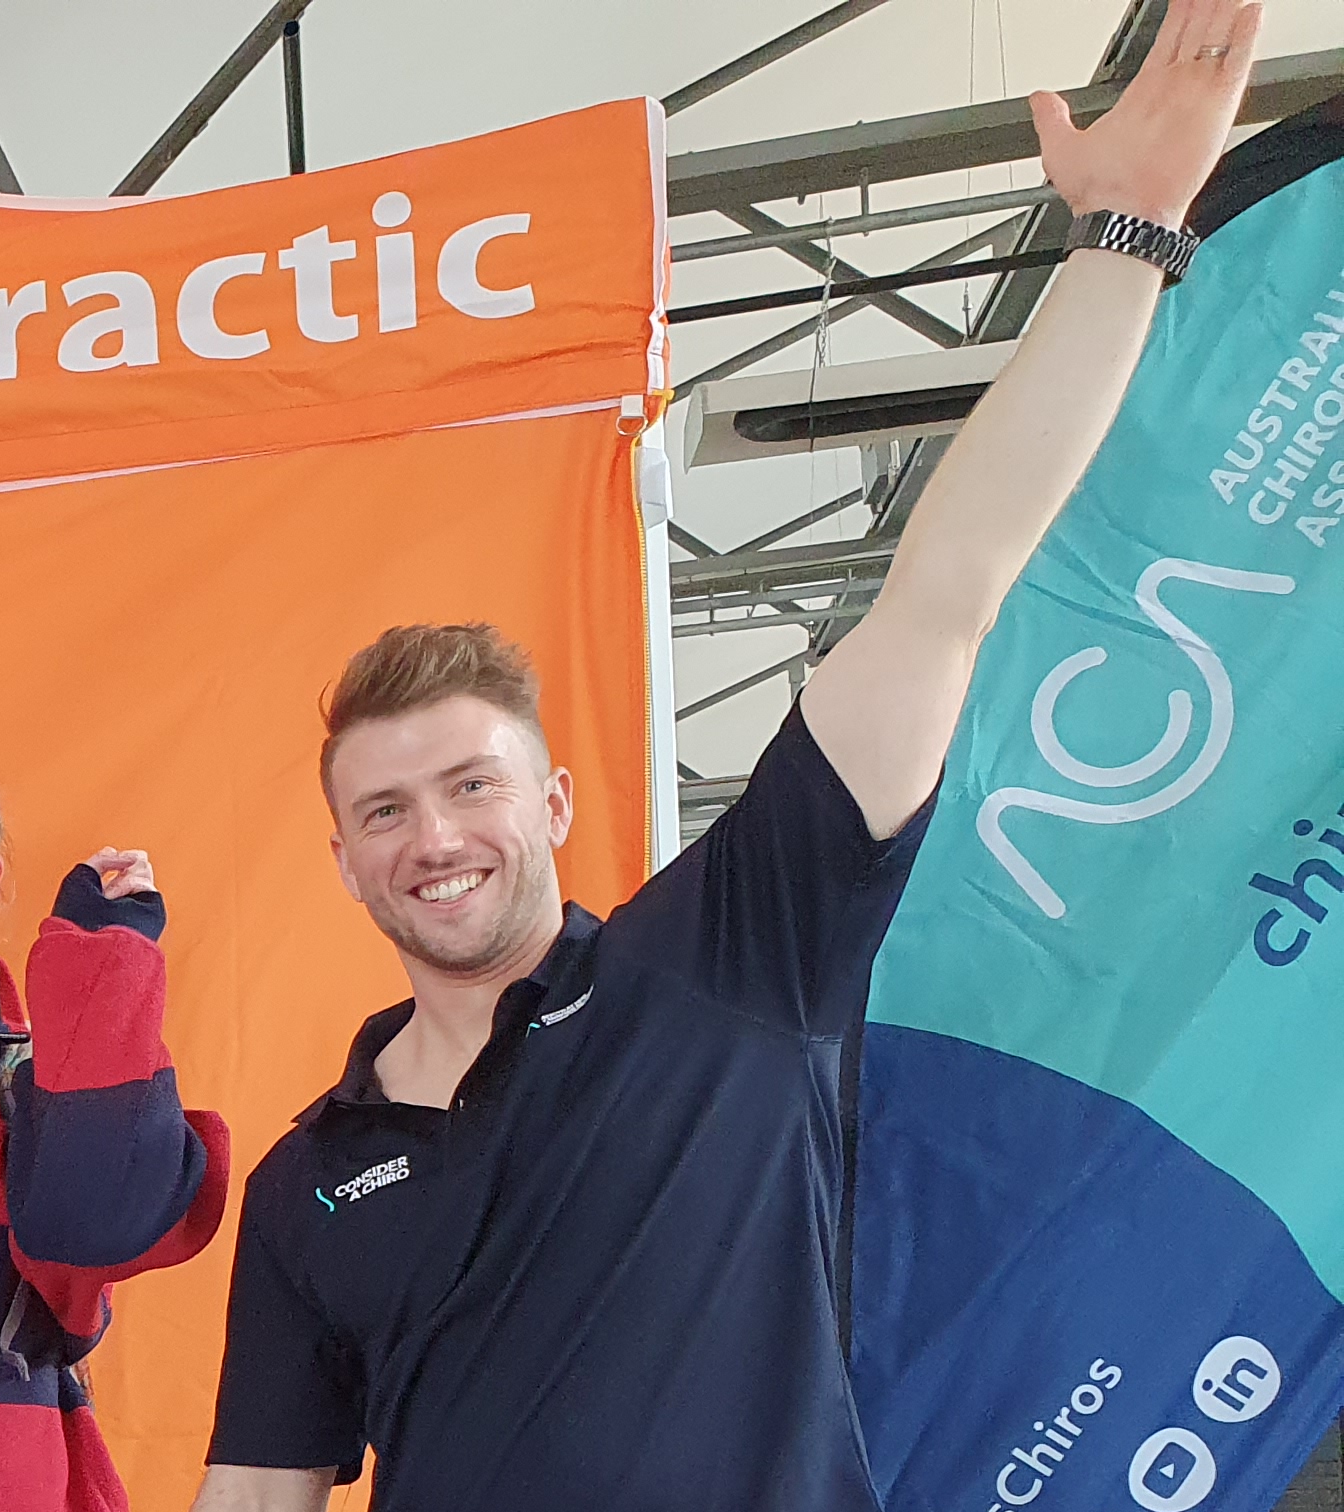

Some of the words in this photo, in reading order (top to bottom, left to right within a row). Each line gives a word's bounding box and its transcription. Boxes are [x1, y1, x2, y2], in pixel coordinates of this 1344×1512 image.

[1248, 802, 1344, 967] chi
[334, 1155, 409, 1198] CONSIDER
[349, 1189, 362, 1202] A
[361, 1167, 410, 1195] CHIRO
